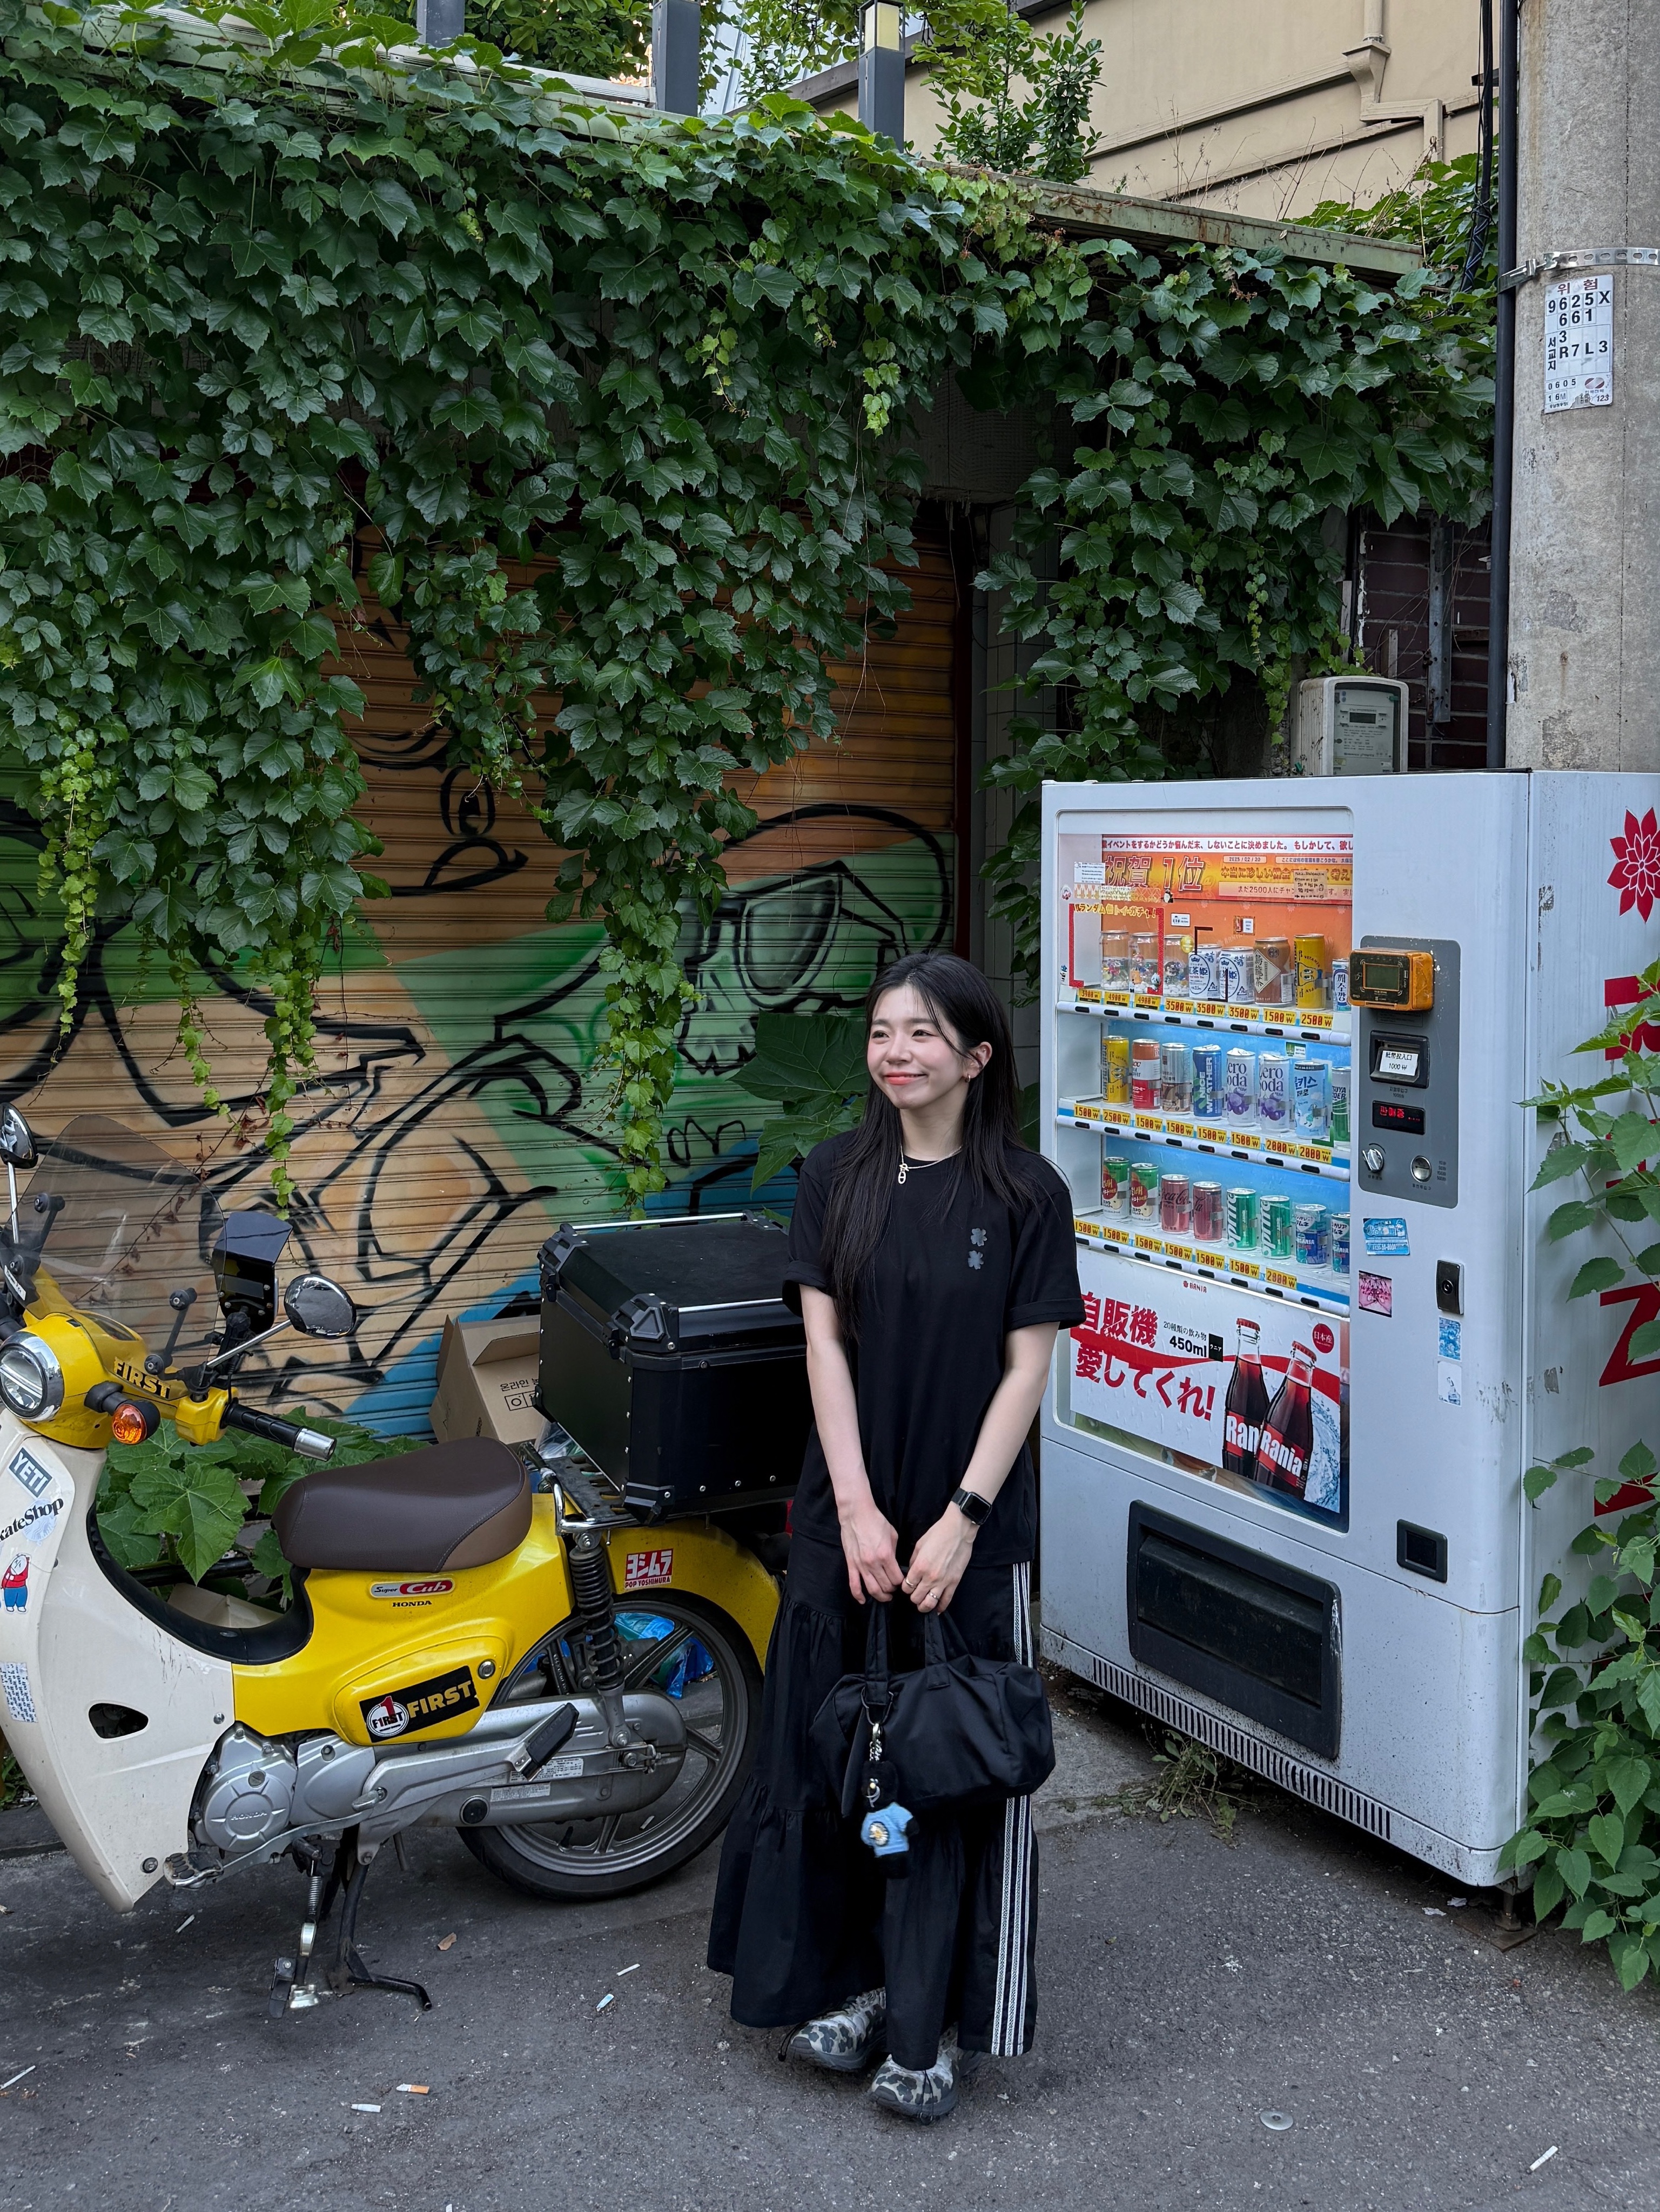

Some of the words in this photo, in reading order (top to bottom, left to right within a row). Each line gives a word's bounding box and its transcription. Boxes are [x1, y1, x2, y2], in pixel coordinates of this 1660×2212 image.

[1557, 278, 1598, 295] 위험
[1548, 291, 1610, 313] 9625X
[1559, 308, 1592, 327] 661
[1559, 330, 1567, 343] 3
[1548, 336, 1556, 370] 서교지
[1548, 378, 1576, 390] 0605
[1105, 855, 1152, 888] 祝賀
[1163, 855, 1205, 892] 1位
[1166, 1000, 1184, 1011] 3500
[1197, 1003, 1215, 1014] 3500
[1229, 1006, 1249, 1019] 3500
[1265, 1010, 1284, 1022] 1500
[1301, 1014, 1322, 1026] 2500
[1227, 1062, 1247, 1074] ero
[1227, 1074, 1247, 1087] oda
[1259, 1078, 1283, 1092] oda
[1075, 1106, 1091, 1117] 1500
[1104, 1111, 1121, 1122] 2500
[1137, 1117, 1153, 1128] 1500
[1167, 1122, 1184, 1134] 1500
[1198, 1128, 1216, 1140] 1500
[1232, 1134, 1251, 1145] 1500
[1267, 1140, 1287, 1152] 2000
[1300, 1147, 1320, 1159] 2000
[1075, 1221, 1091, 1233] 1500
[1104, 1228, 1120, 1240] 1500
[1135, 1237, 1153, 1249] 1500
[1165, 1244, 1182, 1257] 1500
[1197, 1252, 1214, 1266] 1500
[1231, 1260, 1249, 1274] 1500
[1080, 1291, 1158, 1348] 自販機
[1314, 1331, 1333, 1343] 日本産
[1170, 1335, 1207, 1358] 450ml
[113, 1357, 171, 1399] FIRST
[500, 1380, 530, 1392] 온라인
[1260, 1431, 1303, 1478] Rania
[14, 1452, 49, 1494] YETI
[627, 1550, 672, 1580] ヨシムラ
[407, 1582, 447, 1594] Cub
[625, 1580, 637, 1588] POP
[638, 1576, 670, 1587] YOSHIMURA
[407, 1680, 472, 1718] FIRST
